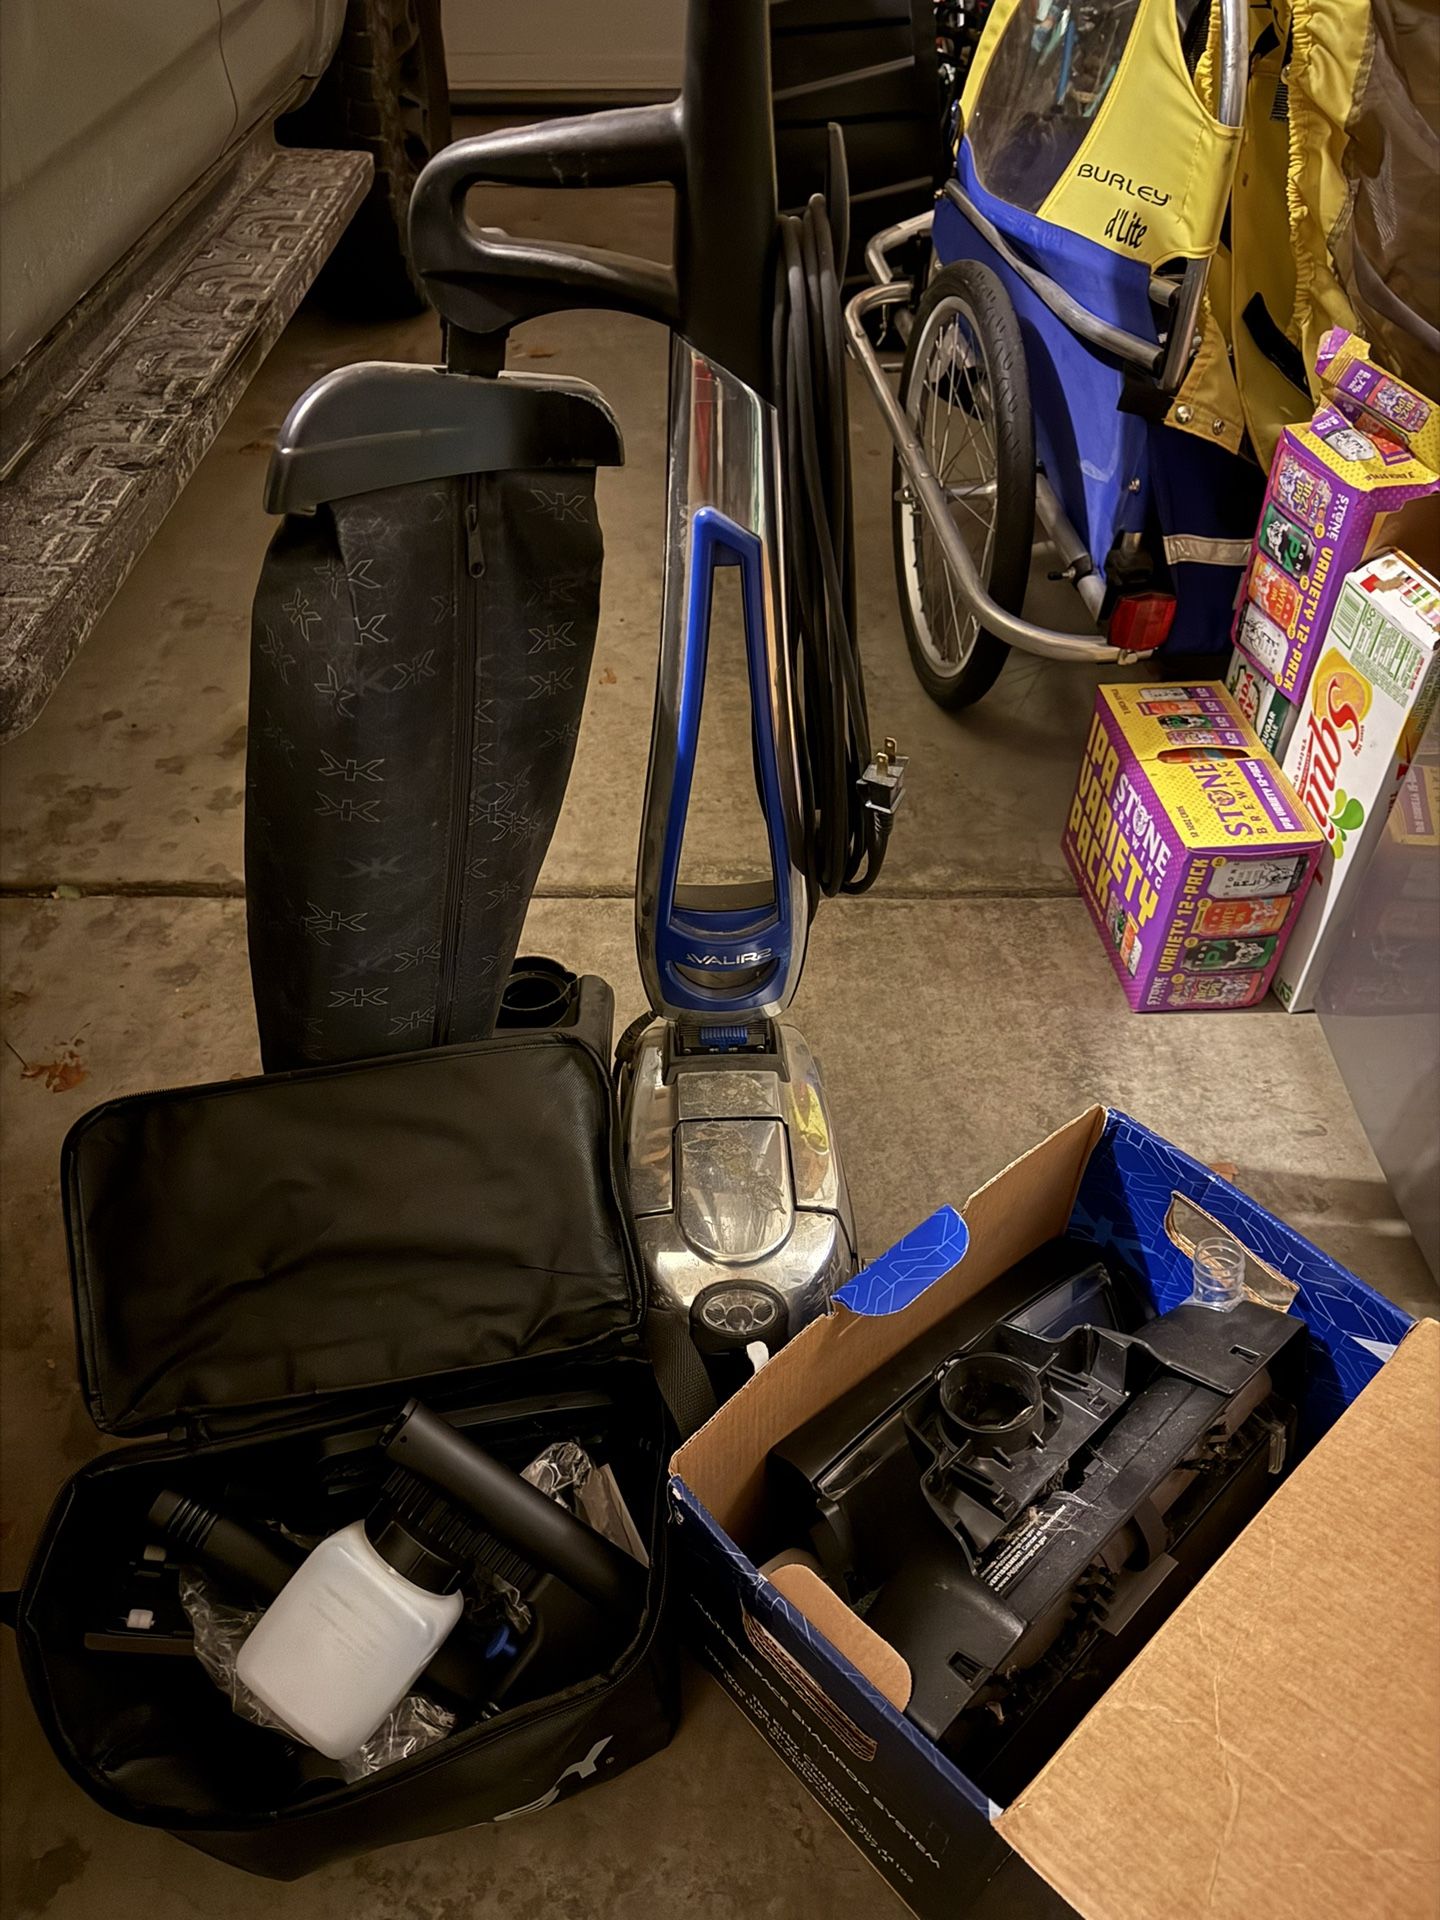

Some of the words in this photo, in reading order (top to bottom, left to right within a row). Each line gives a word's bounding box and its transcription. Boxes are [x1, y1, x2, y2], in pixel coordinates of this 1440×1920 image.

[1077, 163, 1170, 207] BURLEY
[1104, 208, 1148, 249] d'Lite
[1327, 495, 1350, 541] STONE
[1304, 546, 1334, 618] VARIETY
[1282, 622, 1312, 692] 12-PACK
[1086, 712, 1120, 797] IPA
[1262, 711, 1277, 745] SUGAR
[1188, 762, 1254, 836] STONE
[1217, 761, 1268, 834] BREWING
[1245, 761, 1269, 787] 12-PACK
[1261, 787, 1287, 818] VARIETY
[1069, 793, 1112, 912] PACK
[1079, 756, 1160, 928] VARIETY
[1112, 798, 1163, 890] BREWING
[1115, 772, 1171, 879] STONE
[1157, 918, 1188, 973] VARIETY
[1176, 858, 1210, 916] 12-PACK
[791, 1708, 870, 1795] SHAMPOO
[872, 1796, 941, 1869] SYSTEM
[803, 1752, 856, 1812] Company
